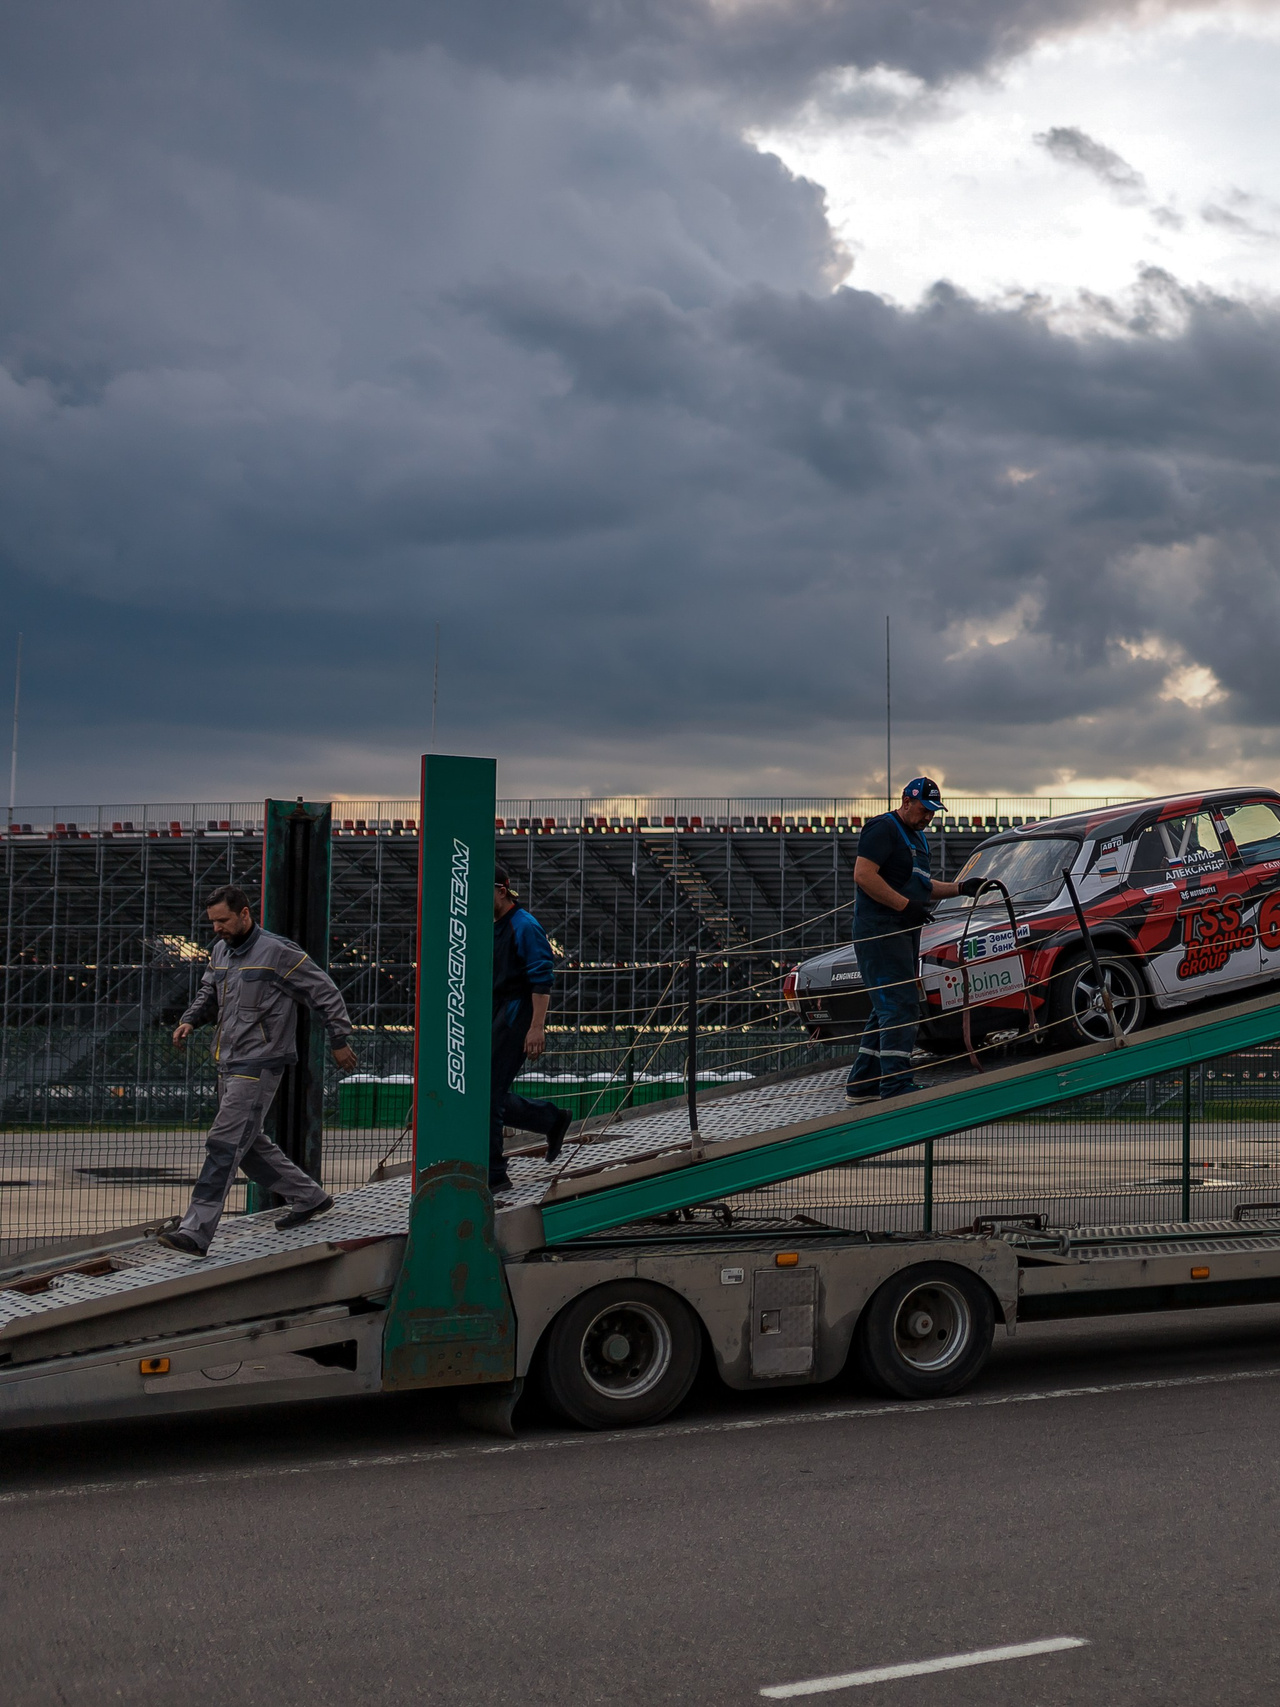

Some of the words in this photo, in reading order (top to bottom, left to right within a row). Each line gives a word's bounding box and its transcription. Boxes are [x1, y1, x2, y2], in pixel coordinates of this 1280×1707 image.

[1102, 840, 1123, 852] АВТО
[1182, 850, 1216, 865] ГАЛИВ
[450, 838, 470, 917] TEAM
[1165, 858, 1225, 881] АЛЕКСАНДР
[1178, 896, 1243, 943] TSS
[989, 926, 1028, 944] Земсий
[992, 942, 1014, 953] банк
[1187, 925, 1254, 961] RACING
[447, 917, 467, 1018] RACING
[1179, 952, 1228, 977] GROUP
[954, 970, 1012, 997] rebina
[974, 988, 998, 999] business
[999, 982, 1024, 993] initiatives
[447, 1012, 466, 1095] SOFIT
